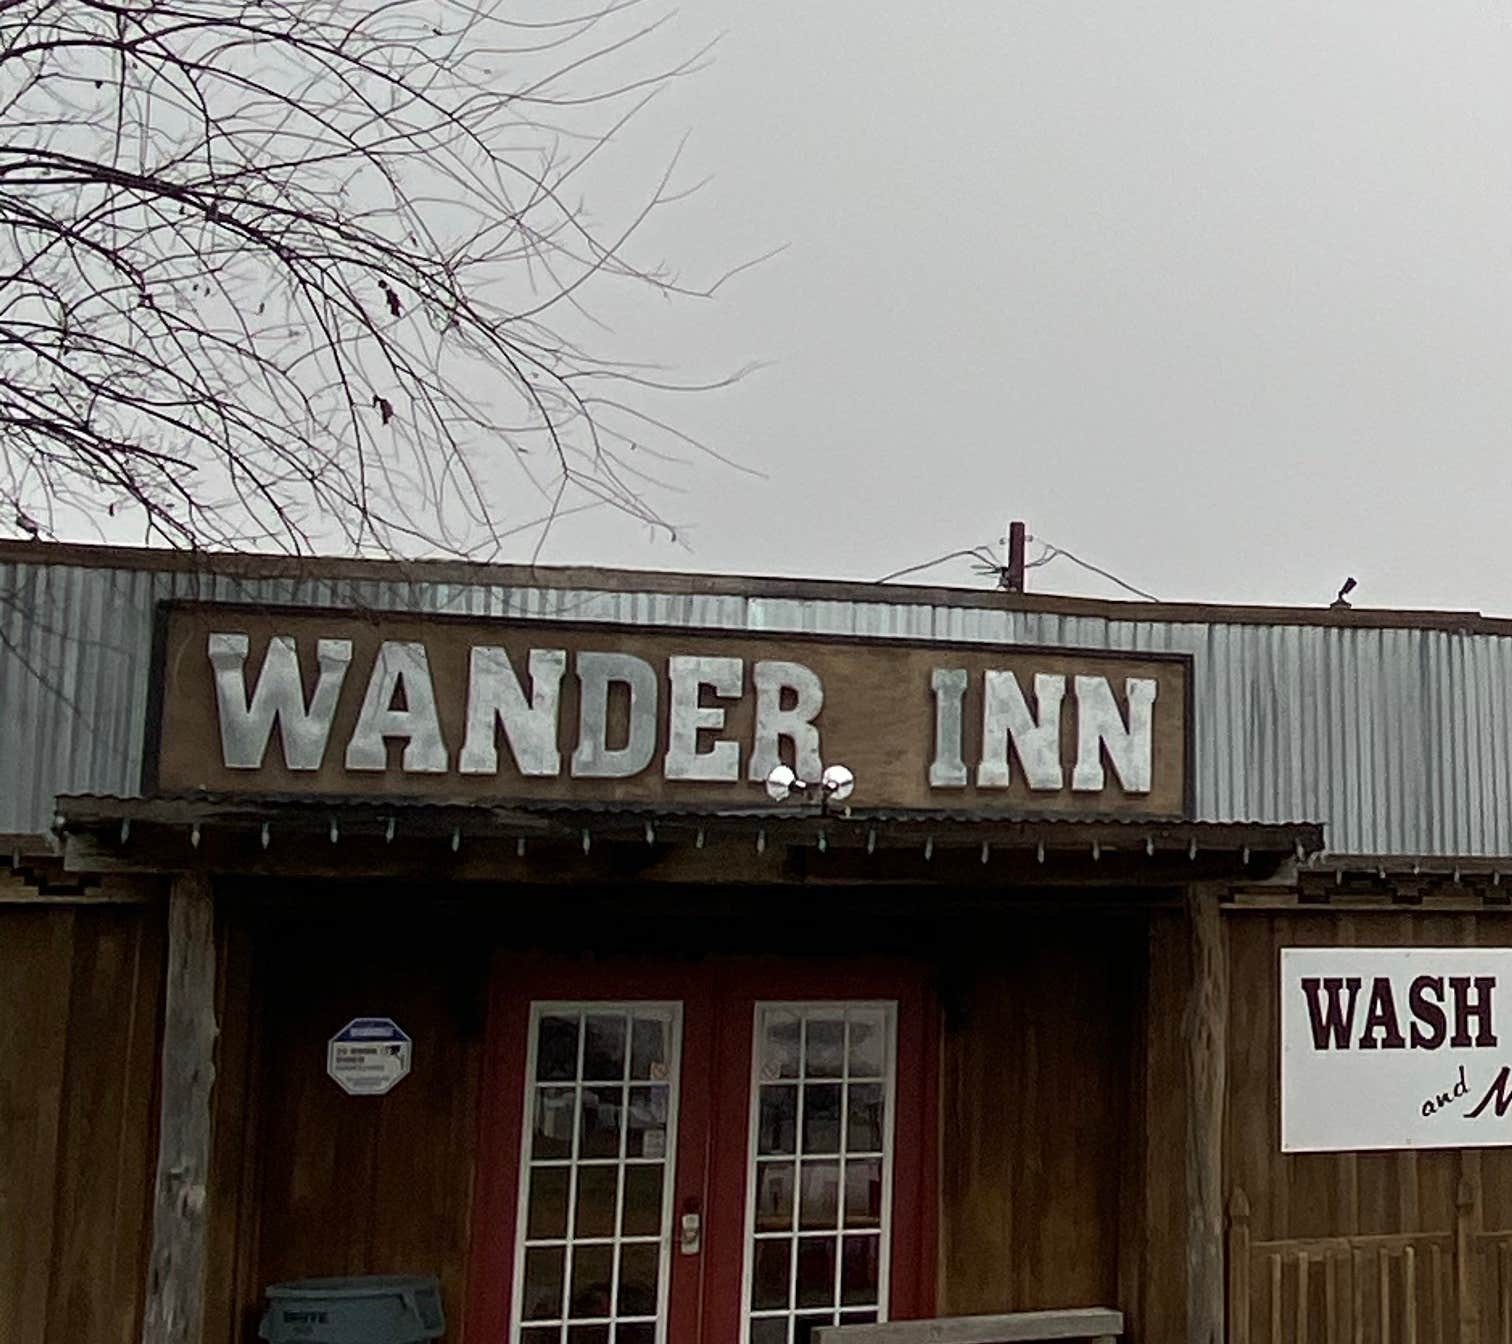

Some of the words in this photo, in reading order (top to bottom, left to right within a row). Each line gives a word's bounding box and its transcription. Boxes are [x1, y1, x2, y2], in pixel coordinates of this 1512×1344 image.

[207, 632, 826, 783] WANDER
[928, 667, 1158, 795] INN
[1300, 975, 1498, 1051] WASH
[1420, 1065, 1471, 1117] and
